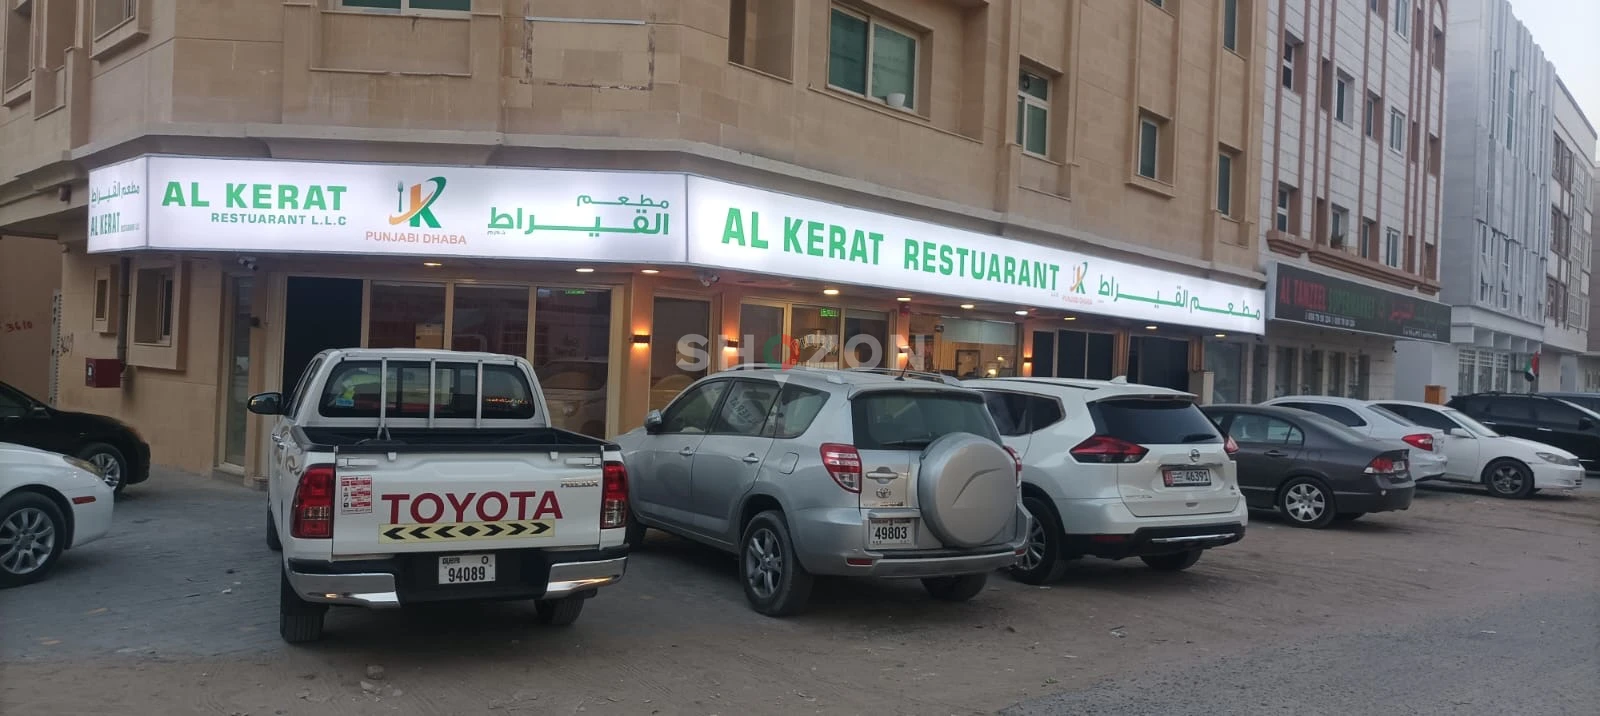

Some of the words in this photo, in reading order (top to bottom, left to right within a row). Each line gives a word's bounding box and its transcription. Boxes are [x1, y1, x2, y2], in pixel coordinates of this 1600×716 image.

[162, 181, 210, 207] AL
[226, 182, 348, 211] KERAT
[577, 194, 670, 209] مطعم
[90, 215, 98, 236] AL
[100, 212, 120, 235] KERAT
[211, 212, 307, 225] RESTUARANT
[311, 215, 347, 226] L.L.C
[487, 207, 670, 237] القيراط
[365, 230, 419, 243] PUNJABI
[423, 232, 467, 245] DHABA
[722, 207, 769, 250] AL
[783, 216, 884, 266] KERAT
[904, 238, 1060, 291] RESTUARANT
[1098, 274, 1189, 309] القيراط
[1190, 296, 1261, 320] مطعم
[381, 490, 563, 525] TOYOTA
[874, 526, 908, 540] 49803
[448, 566, 486, 583] 94089
